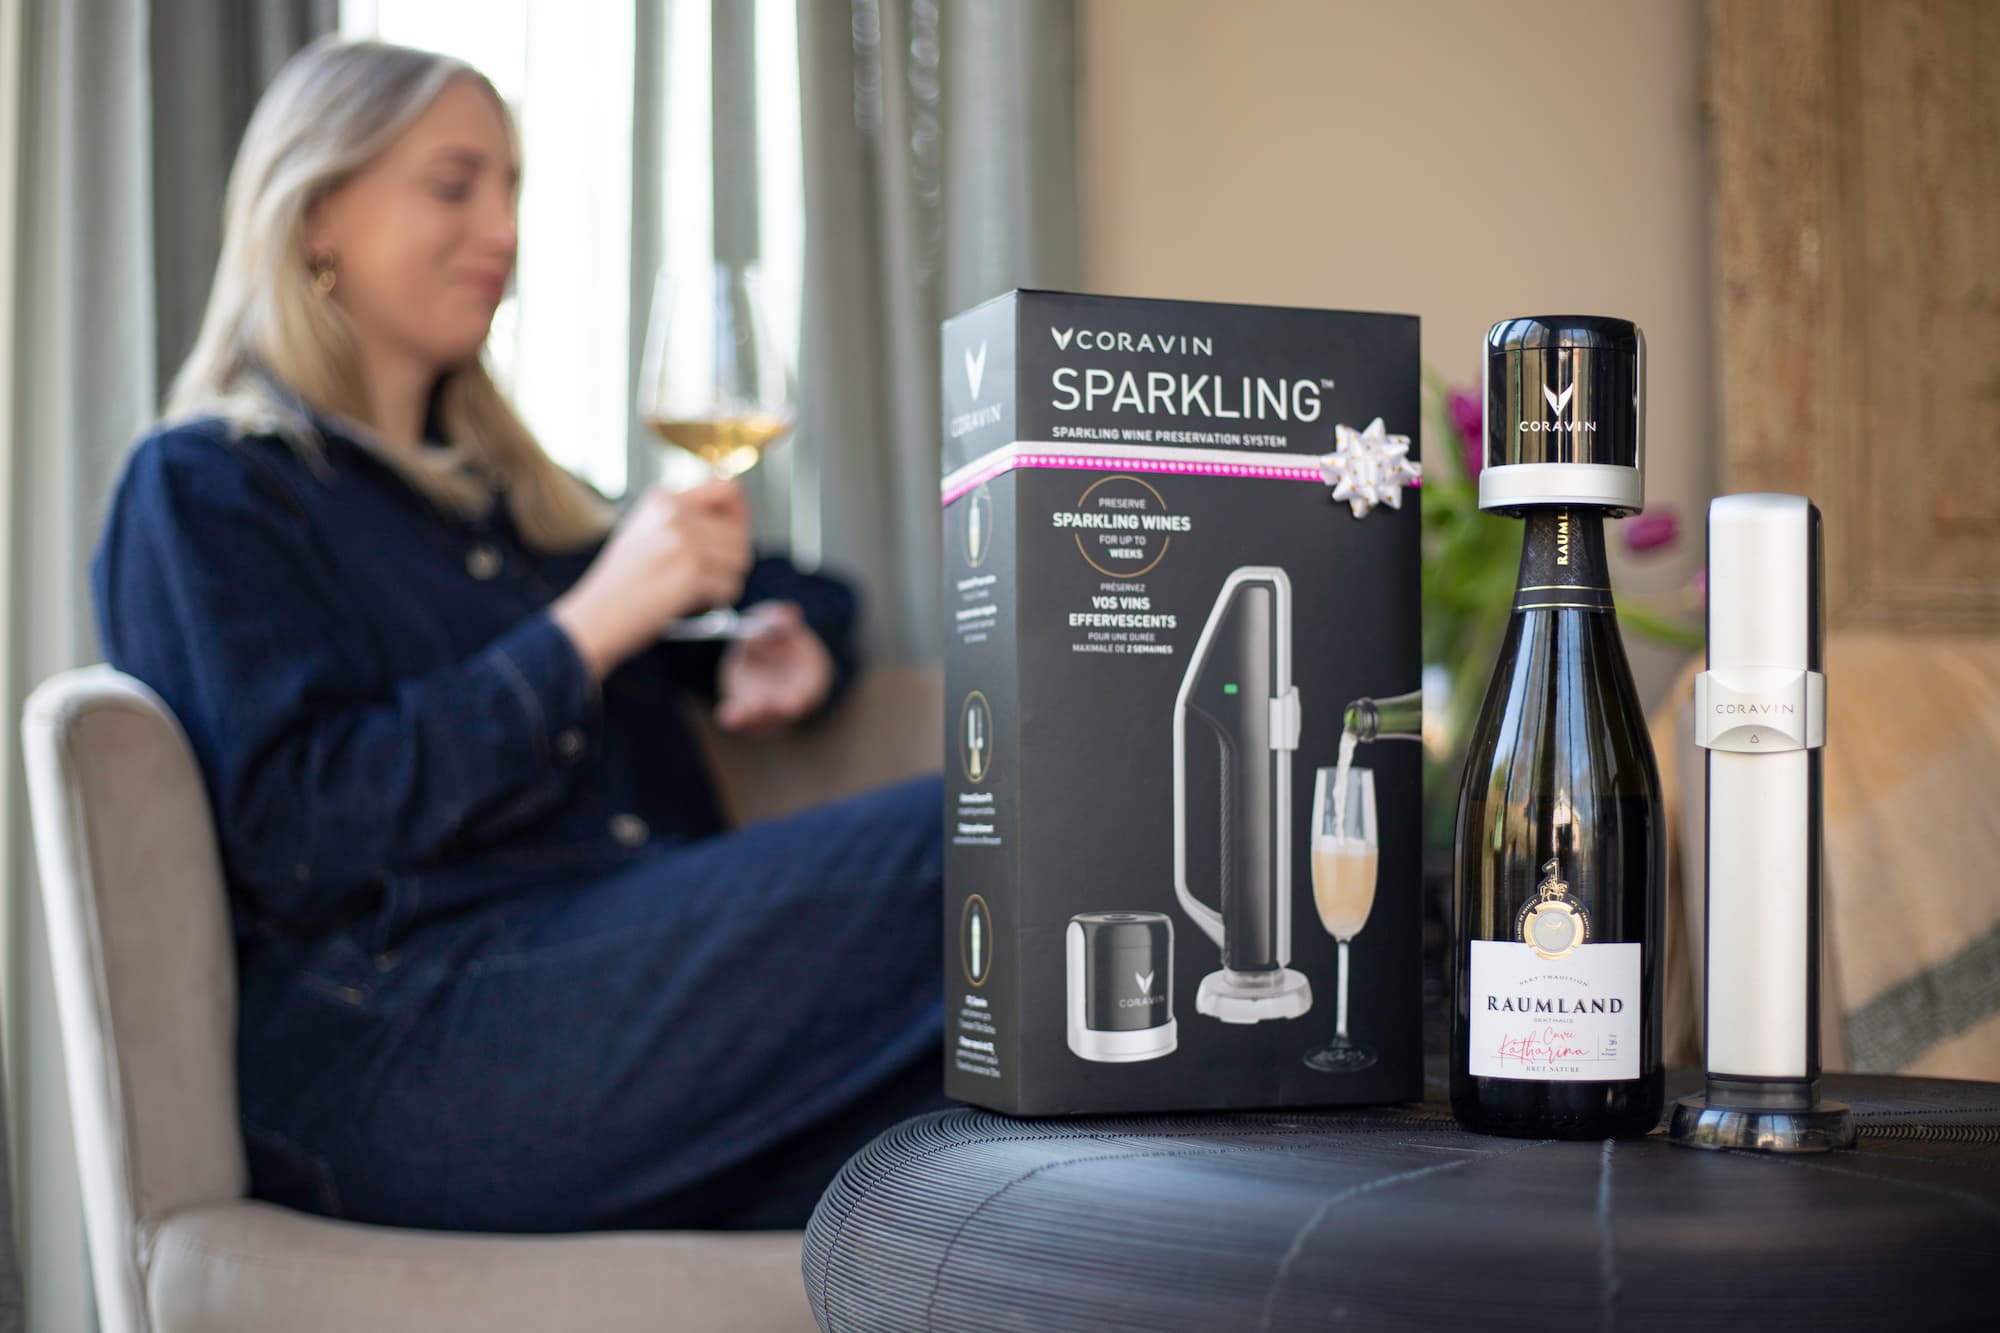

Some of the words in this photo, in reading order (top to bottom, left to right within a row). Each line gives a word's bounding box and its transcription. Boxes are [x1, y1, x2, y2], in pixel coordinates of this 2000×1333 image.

[1076, 330, 1213, 356] CORAVIN
[1519, 420, 1597, 433] CORAVIN
[1052, 426, 1120, 440] SPARKLING
[1122, 429, 1153, 442] WINE
[1155, 431, 1241, 446] PRESERVATION
[1242, 434, 1287, 447] SYSTEM
[1098, 498, 1147, 510] PRESERVE
[1053, 512, 1139, 530] SPARKLING
[1141, 515, 1192, 532] WINES
[1099, 534, 1118, 545] FOR
[1119, 535, 1133, 545] UP
[1134, 536, 1147, 546] TO
[1557, 506, 1569, 566] RAUML
[1109, 548, 1143, 559] WEEKS
[1092, 596, 1118, 609] VOS
[1119, 597, 1151, 610] VINS
[1069, 613, 1177, 628] EFFERVESCENTS
[1088, 631, 1110, 641] POUR
[1111, 632, 1128, 641] UNE
[1072, 643, 1114, 653] MAXIMALE
[1114, 644, 1126, 653] DE
[1132, 645, 1173, 655] SEMAINES
[1715, 704, 1794, 714] CORAVIN
[1487, 995, 1624, 1013] RAUMLAND
